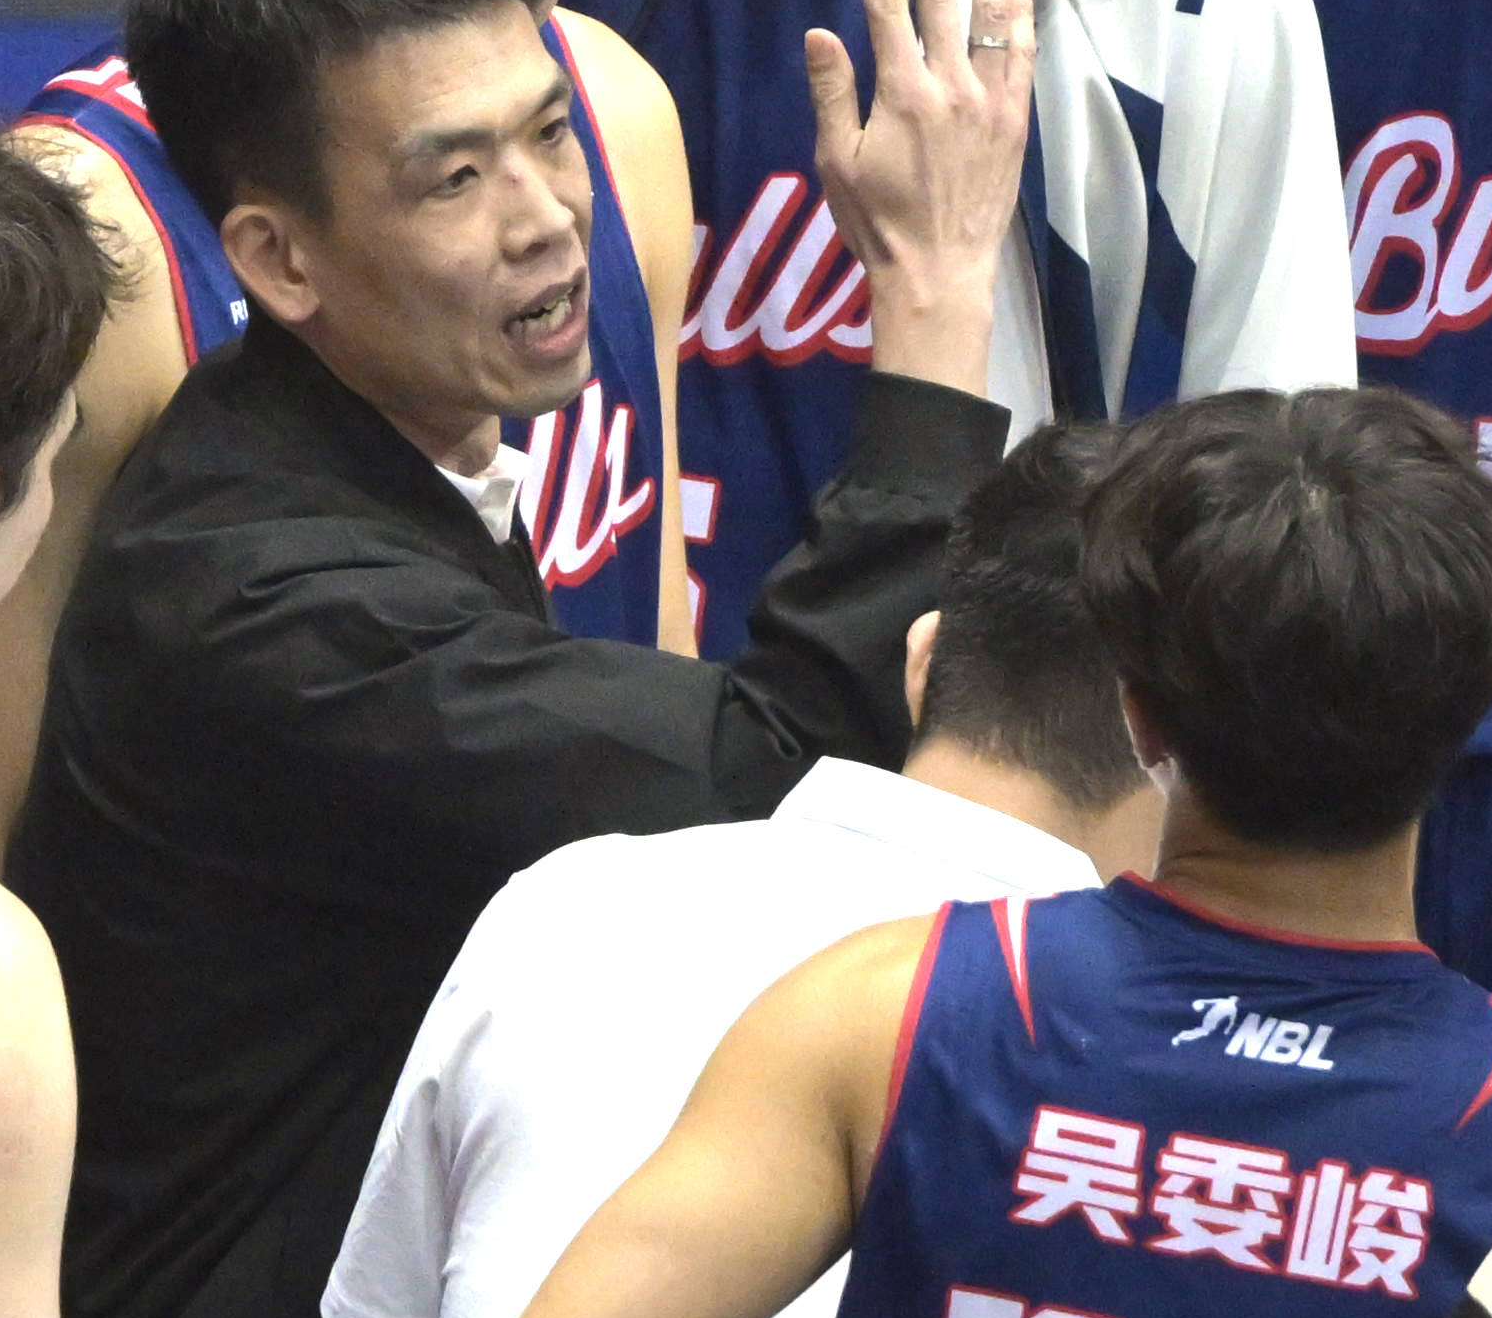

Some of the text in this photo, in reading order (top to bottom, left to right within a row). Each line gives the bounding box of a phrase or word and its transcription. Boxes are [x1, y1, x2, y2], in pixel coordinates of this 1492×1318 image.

[1225, 1011, 1335, 1071] NBL
[1009, 1103, 1435, 1300] 吴委峻
